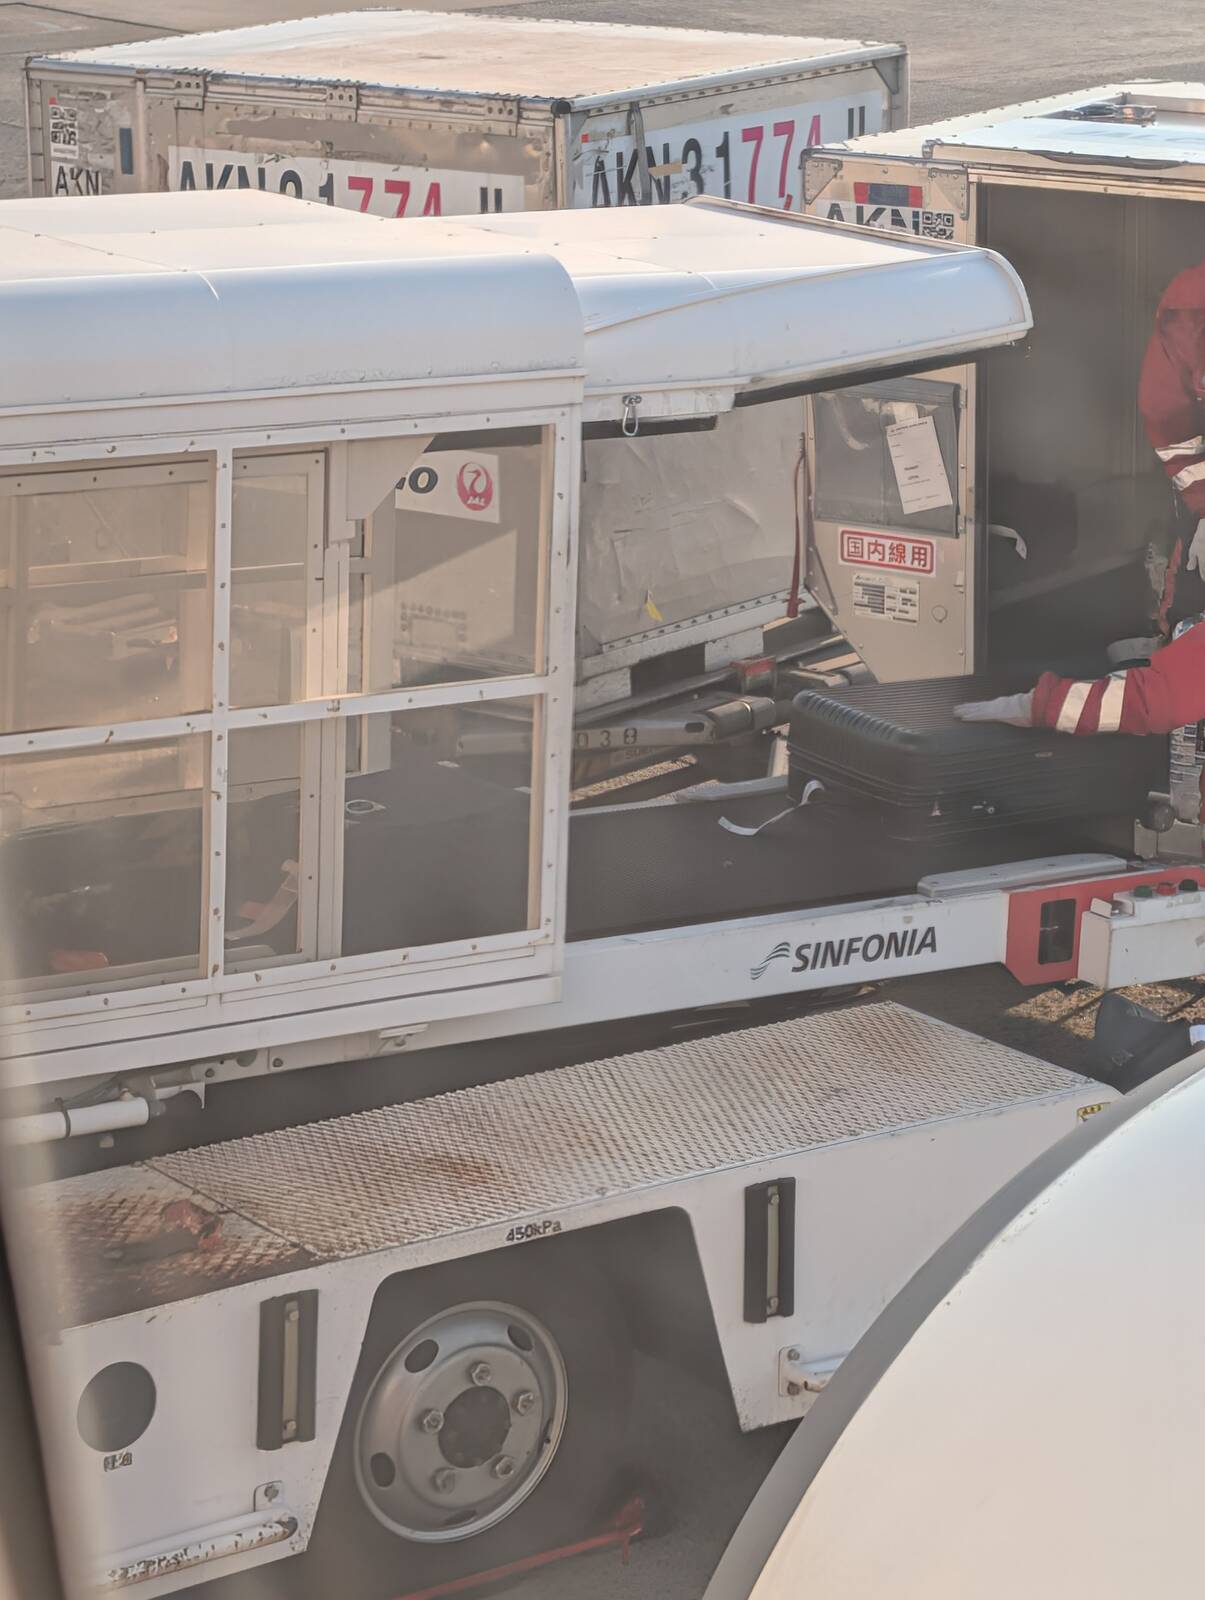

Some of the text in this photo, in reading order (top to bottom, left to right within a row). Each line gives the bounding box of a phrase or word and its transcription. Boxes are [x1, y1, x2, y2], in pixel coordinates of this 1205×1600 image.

[846, 536, 928, 568] 国内線用
[791, 926, 937, 973] SINFONIA
[506, 1220, 562, 1242] 450kPa
